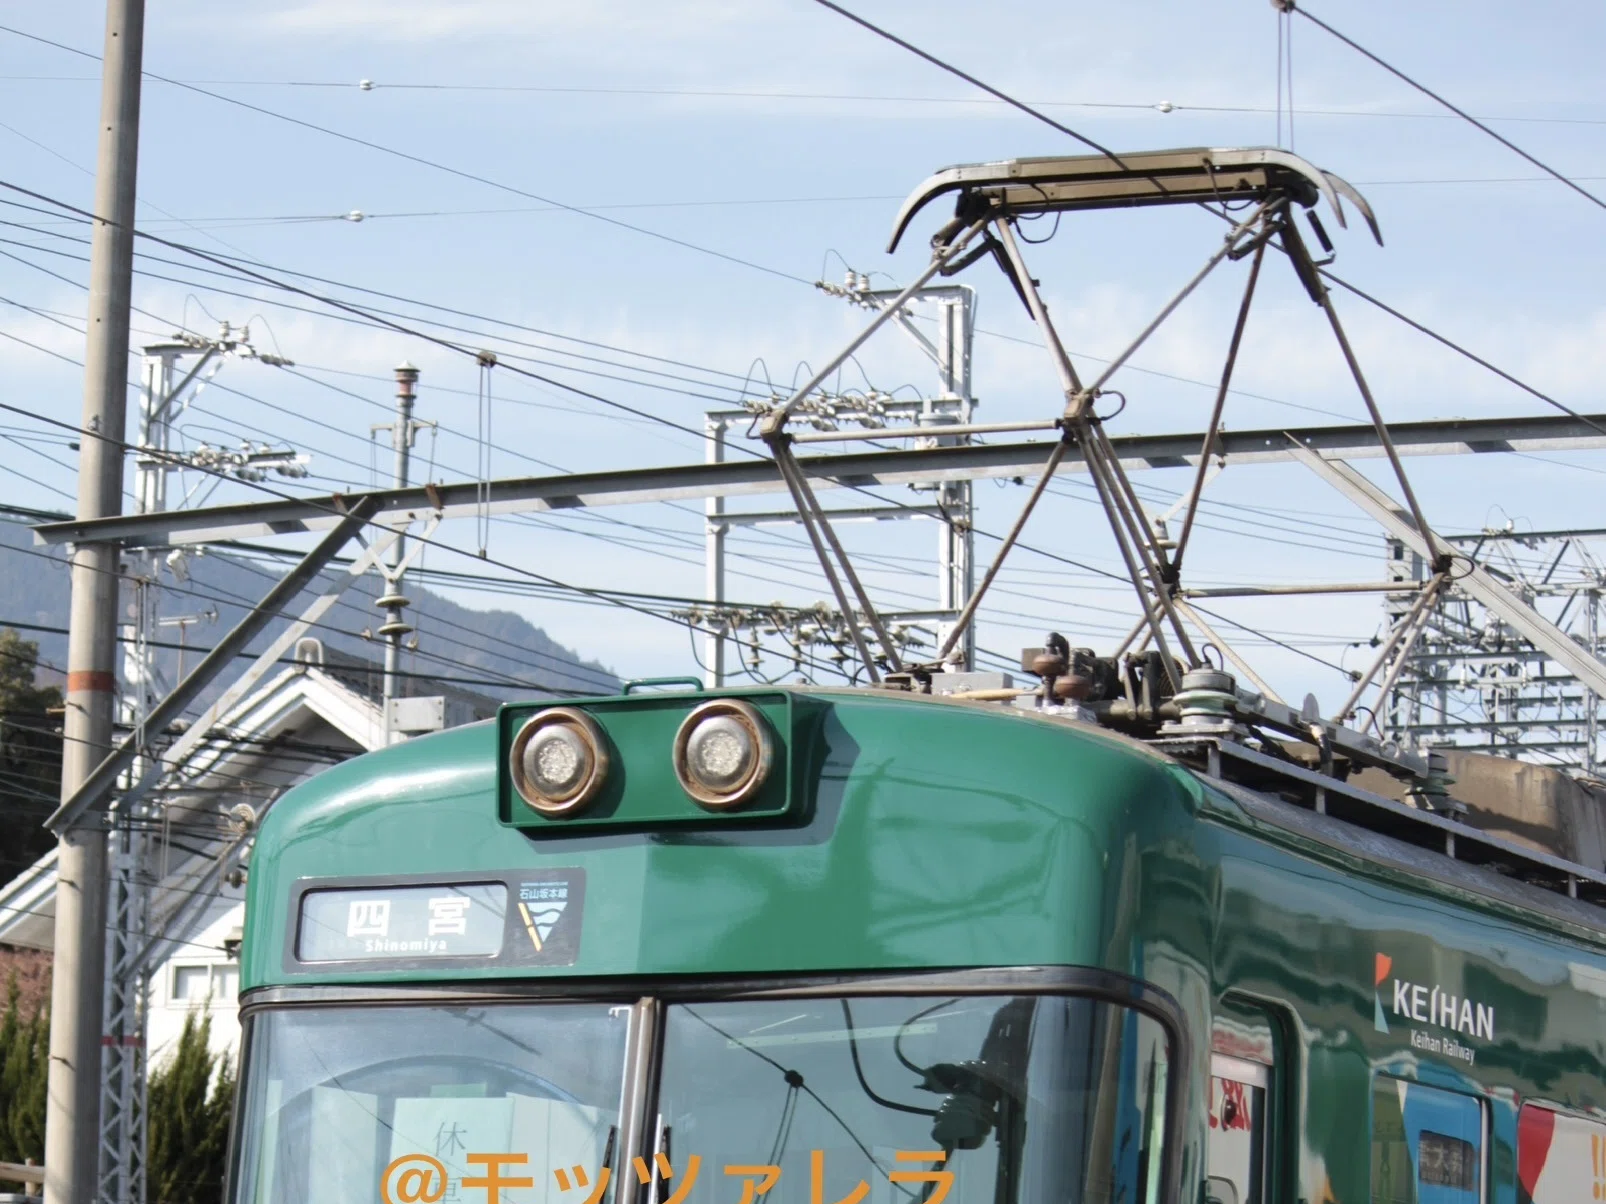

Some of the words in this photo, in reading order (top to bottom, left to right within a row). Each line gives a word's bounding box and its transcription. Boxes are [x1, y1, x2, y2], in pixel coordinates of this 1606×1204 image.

[346, 895, 471, 937] 四宮
[365, 938, 447, 953] Shinomiya
[1393, 979, 1494, 1041] KEIHAN
[1410, 1029, 1441, 1053] Keihan
[1442, 1037, 1475, 1066] Railway
